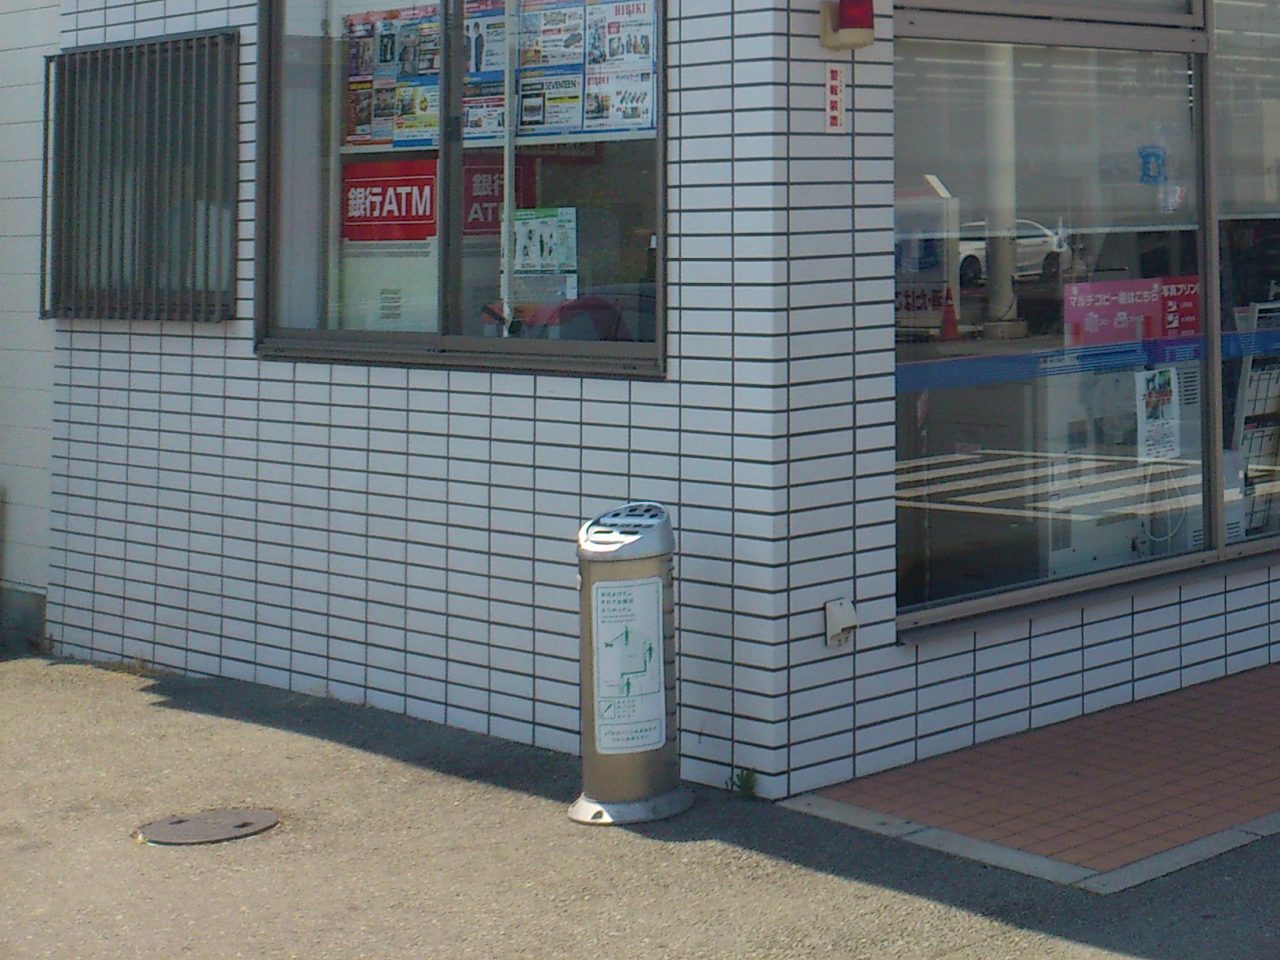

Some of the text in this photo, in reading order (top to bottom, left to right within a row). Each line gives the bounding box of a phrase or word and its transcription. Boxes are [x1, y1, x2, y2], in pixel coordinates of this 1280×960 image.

[348, 185, 431, 218] 銀行ATM
[467, 202, 499, 223] AT
[1161, 282, 1200, 297] 写真プリン
